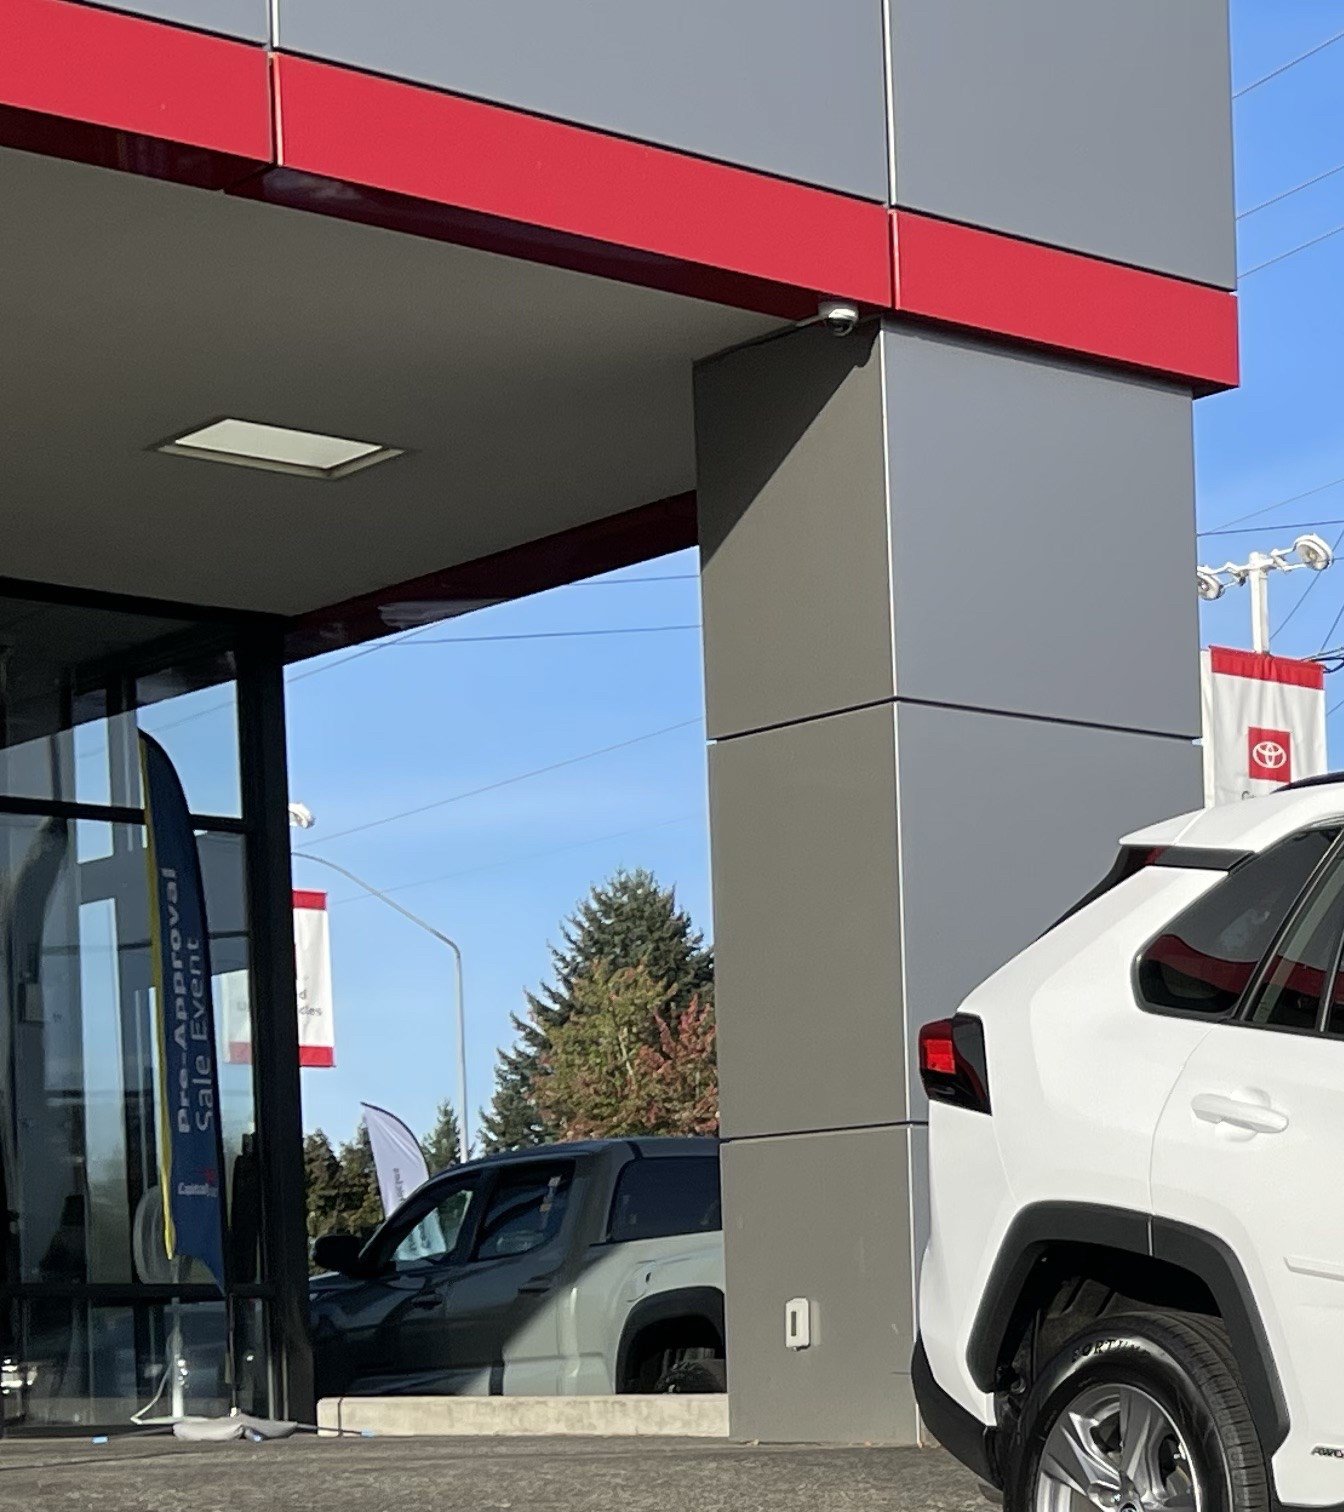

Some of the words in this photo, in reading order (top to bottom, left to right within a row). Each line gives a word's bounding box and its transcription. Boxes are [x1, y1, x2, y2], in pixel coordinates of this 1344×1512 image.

[161, 866, 191, 1134] Pre-Approval
[187, 938, 209, 1041] Event
[195, 1053, 213, 1132] Sale
